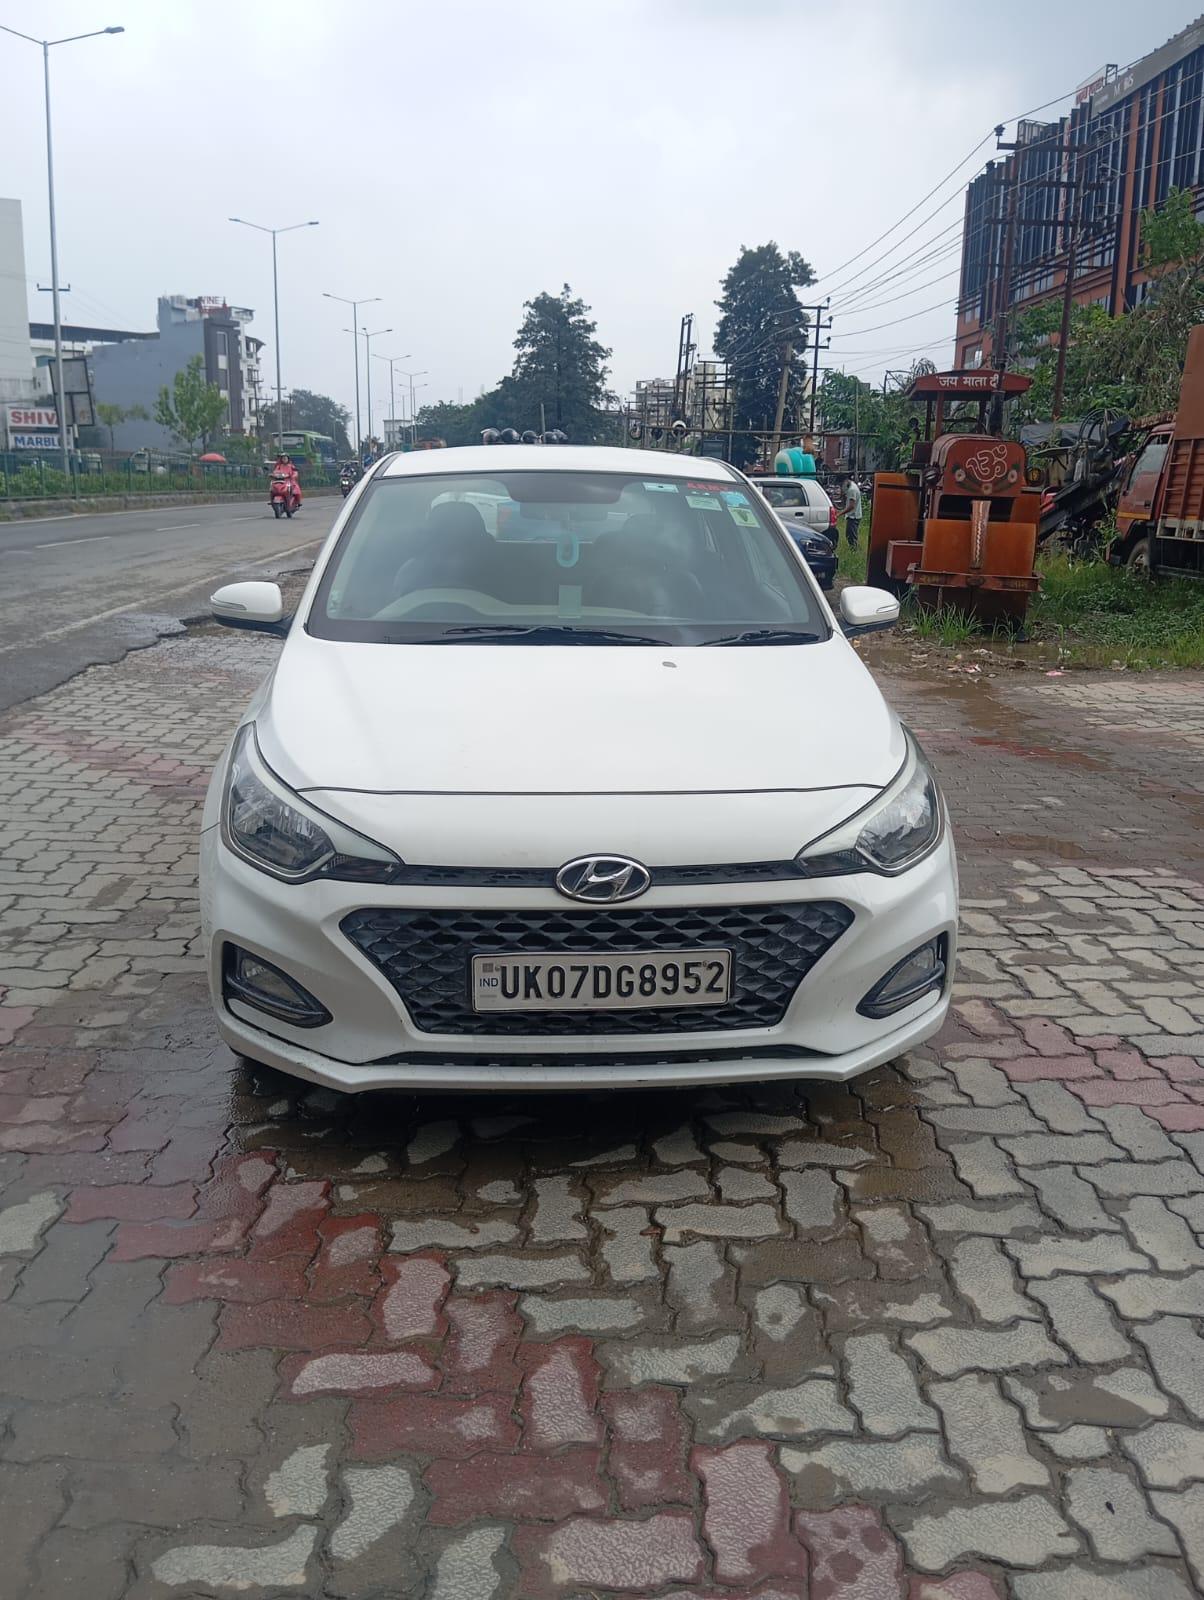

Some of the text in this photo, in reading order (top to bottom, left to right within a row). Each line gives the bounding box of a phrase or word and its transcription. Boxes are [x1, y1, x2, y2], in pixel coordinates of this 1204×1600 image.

[963, 376, 987, 387] माता
[11, 411, 57, 425] SHIV
[479, 961, 725, 999] IND UK07DG8952
